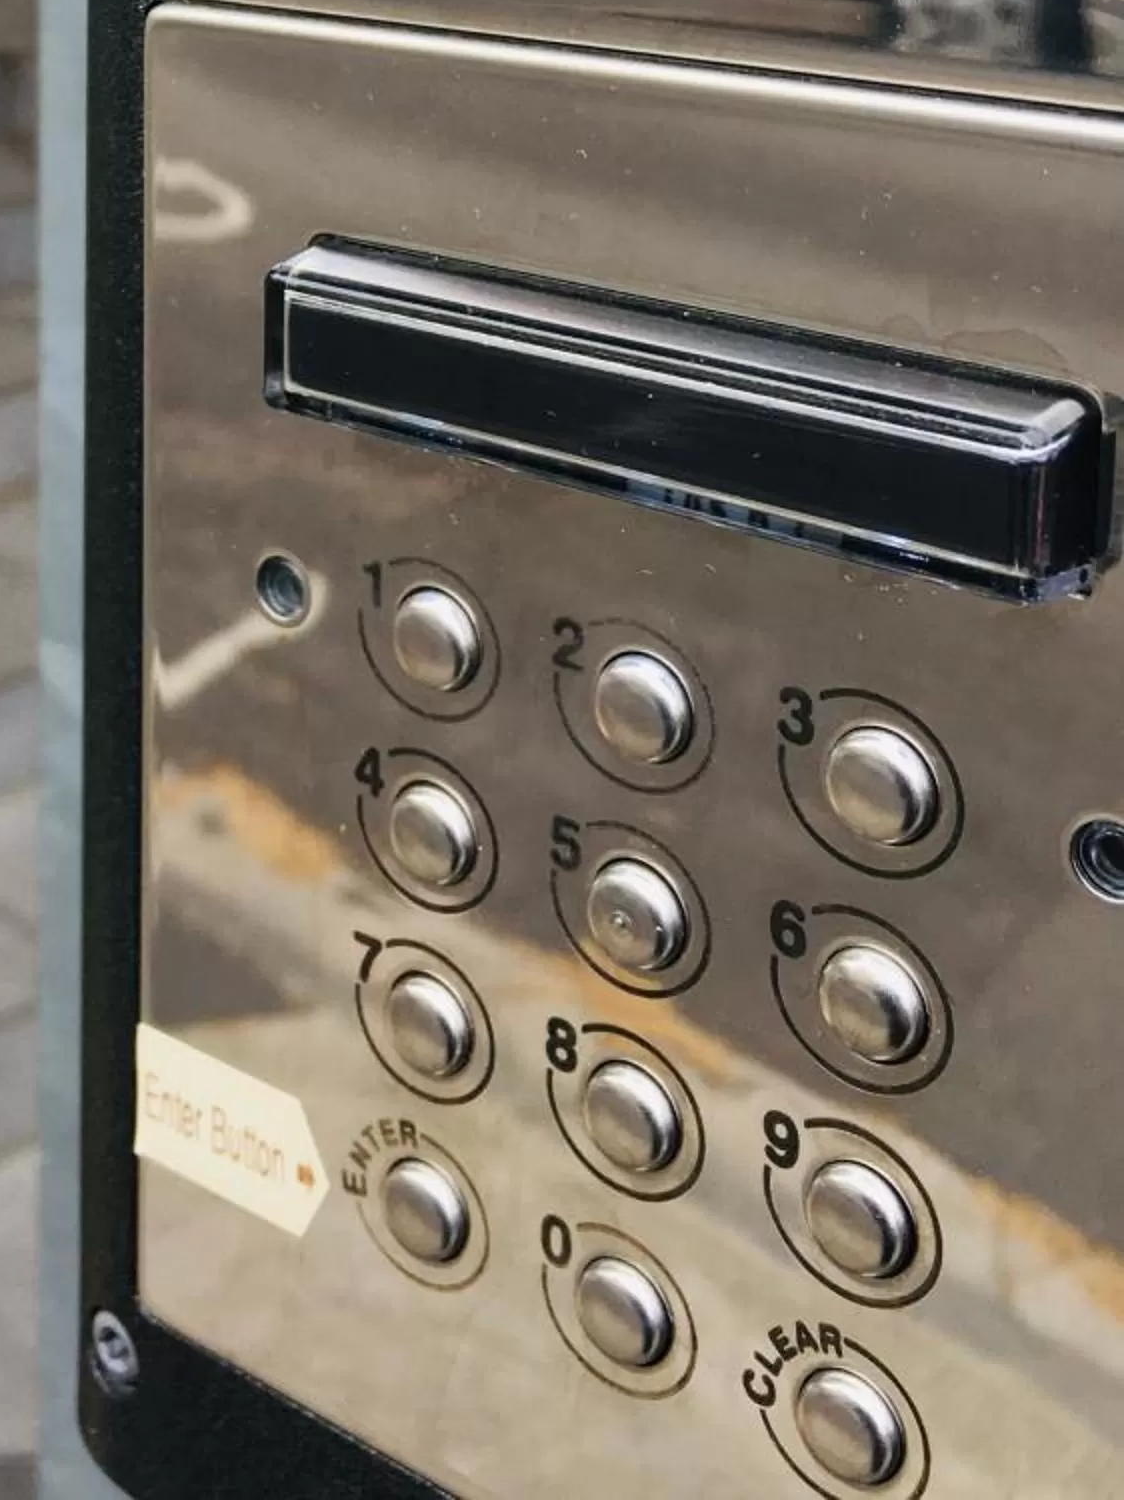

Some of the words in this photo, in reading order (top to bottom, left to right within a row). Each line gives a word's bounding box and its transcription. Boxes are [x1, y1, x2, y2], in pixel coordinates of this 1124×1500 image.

[363, 560, 382, 607] 1
[552, 616, 586, 671] 2
[778, 686, 815, 746] 3
[355, 746, 385, 797] 4
[550, 814, 582, 871] 5
[352, 930, 383, 983] 7
[770, 899, 807, 959] 6
[545, 1016, 578, 1073] 8
[143, 1070, 202, 1142] Enter
[210, 1105, 286, 1186] Button
[763, 1110, 801, 1169] 9
[342, 1117, 420, 1198] ENTER
[742, 1320, 844, 1408] CLEAR
